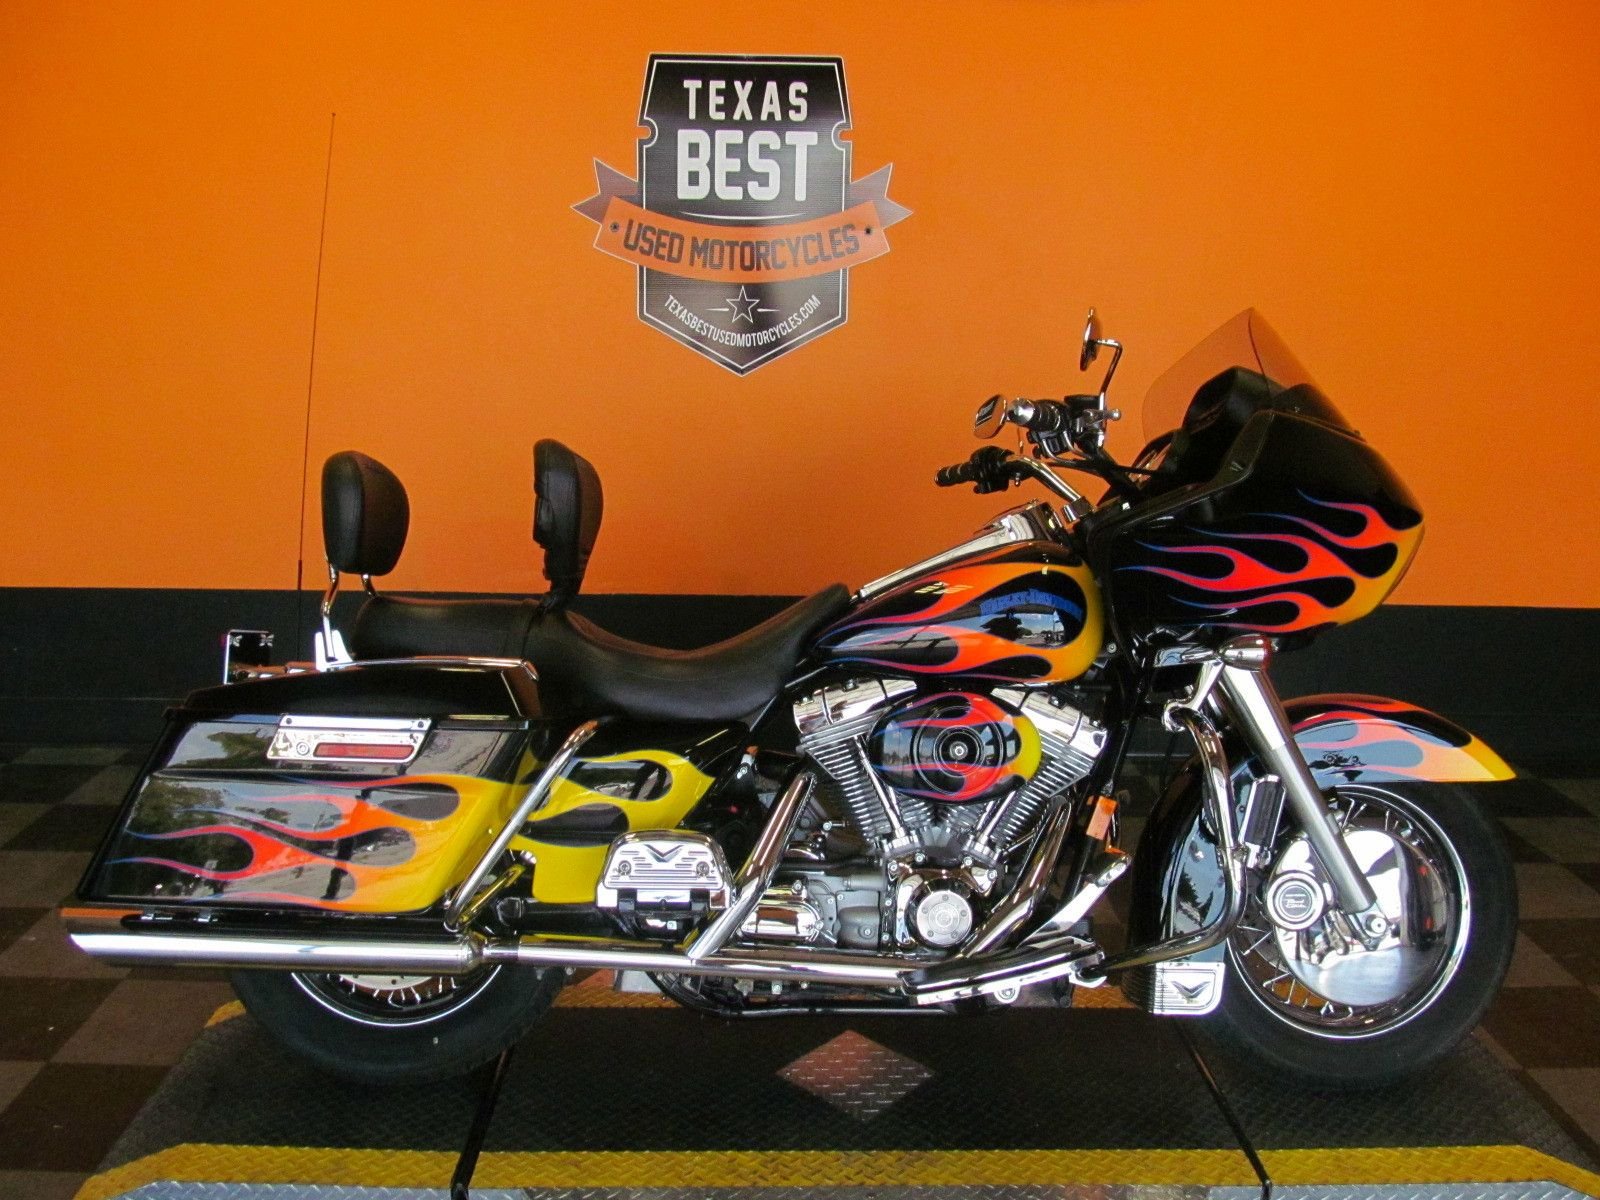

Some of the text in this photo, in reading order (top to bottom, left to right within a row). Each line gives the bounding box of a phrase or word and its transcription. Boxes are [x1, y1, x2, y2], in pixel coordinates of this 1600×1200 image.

[683, 79, 808, 121] TEXAS
[677, 129, 818, 201] BEST
[623, 219, 860, 272] USED MOTORCYCLES
[664, 294, 821, 347] TEXASBESTUSEDMOTORCYCLES.COM
